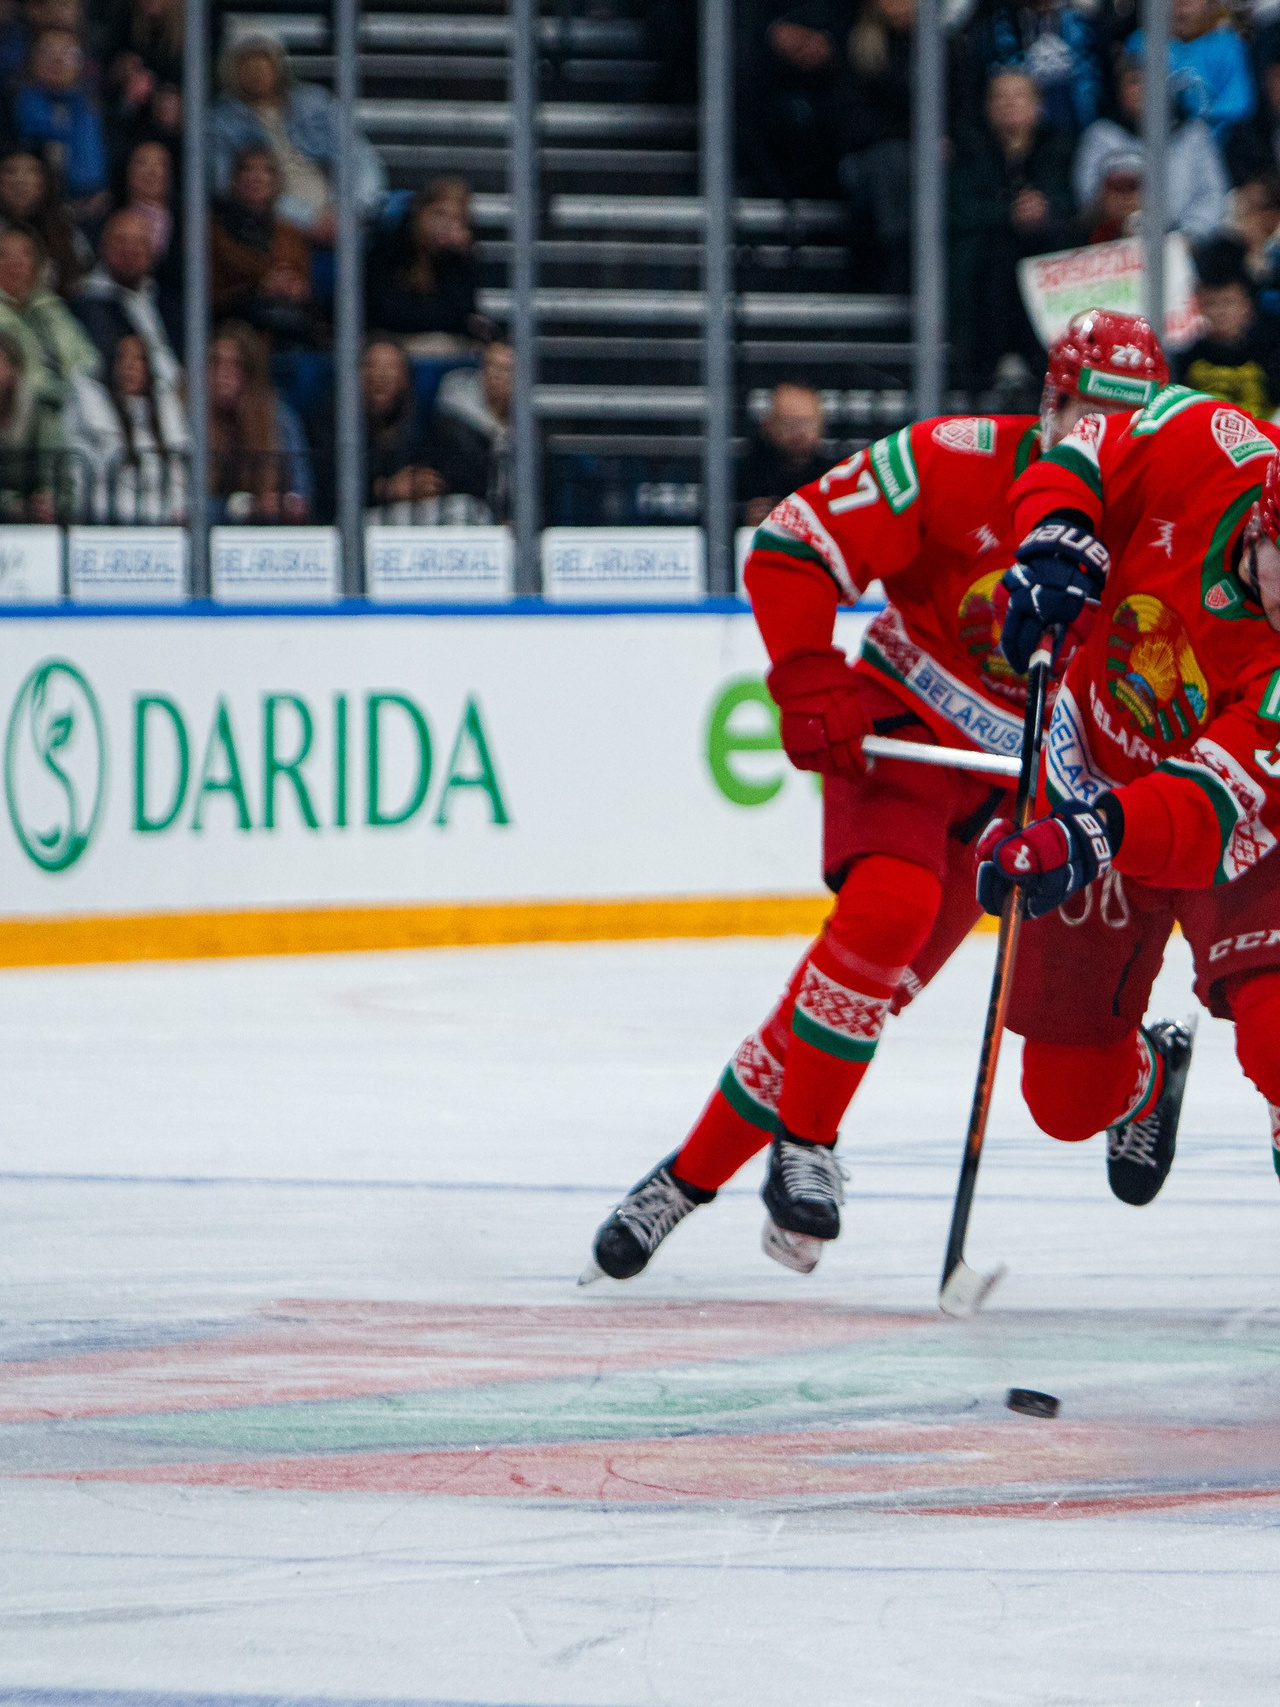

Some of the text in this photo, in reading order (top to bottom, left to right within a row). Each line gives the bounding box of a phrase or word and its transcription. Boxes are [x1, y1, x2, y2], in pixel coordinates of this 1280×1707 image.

[1111, 344, 1142, 368] 27
[913, 667, 1023, 756] BELARUS
[131, 689, 512, 833] DARIDA
